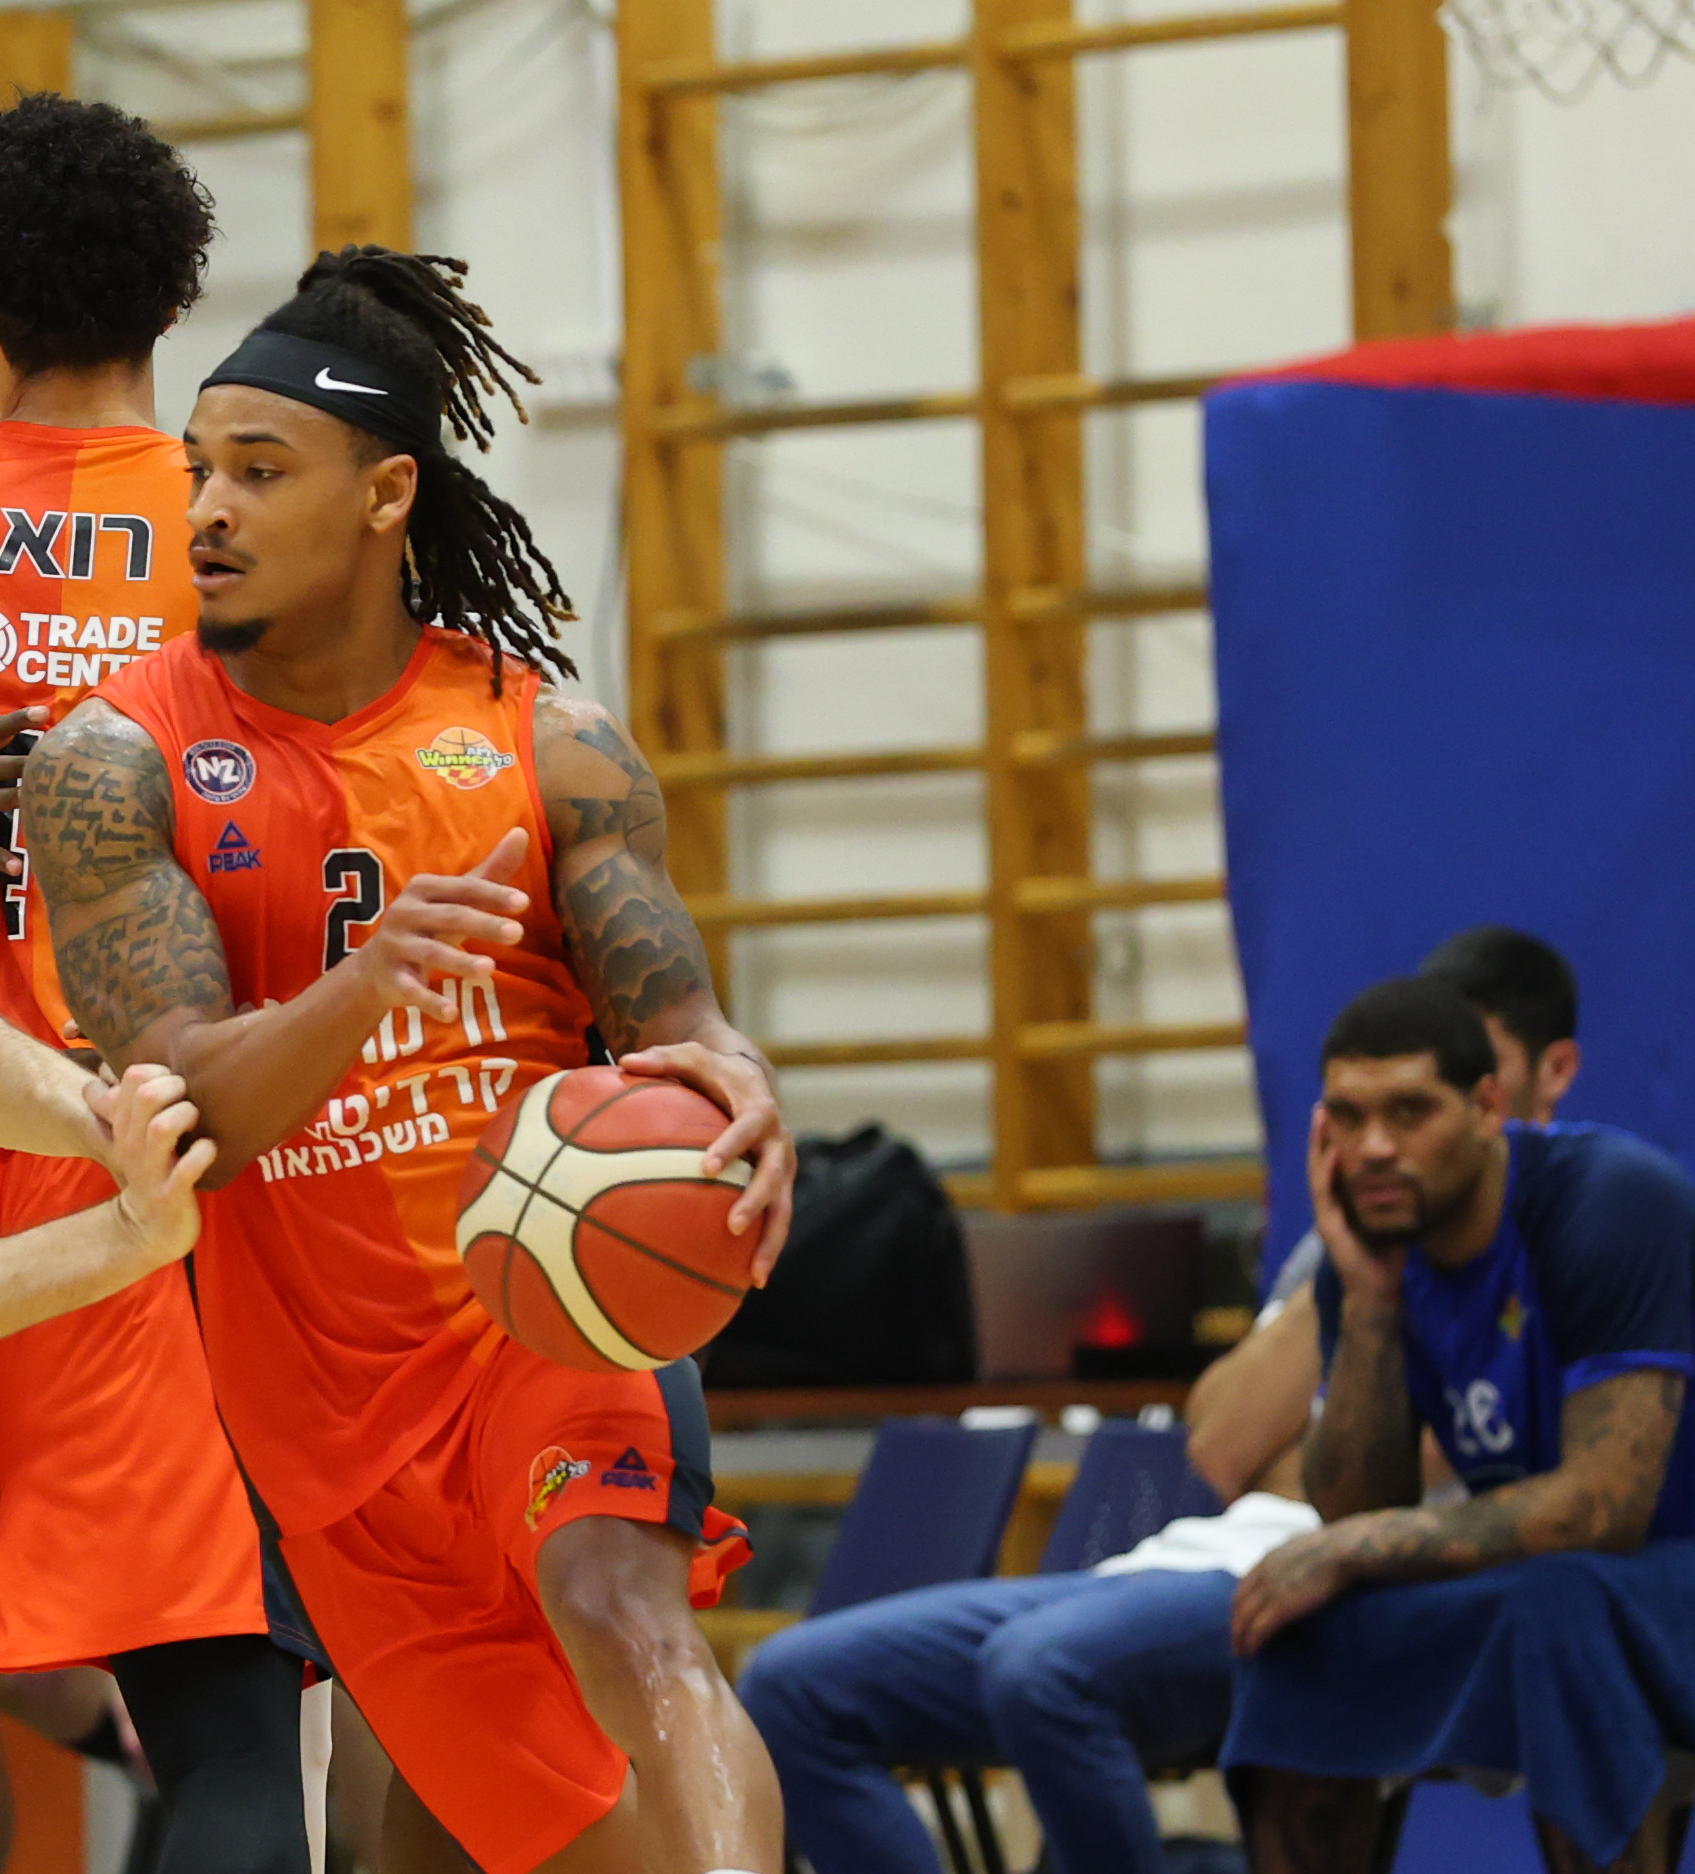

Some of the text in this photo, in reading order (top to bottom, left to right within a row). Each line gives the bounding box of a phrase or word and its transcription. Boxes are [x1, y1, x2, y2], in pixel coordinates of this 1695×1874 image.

[19, 611, 164, 652] TRADE
[16, 649, 143, 687] CENT
[196, 756, 240, 784] NZ
[417, 750, 493, 767] Winner
[208, 849, 262, 874] PEAK
